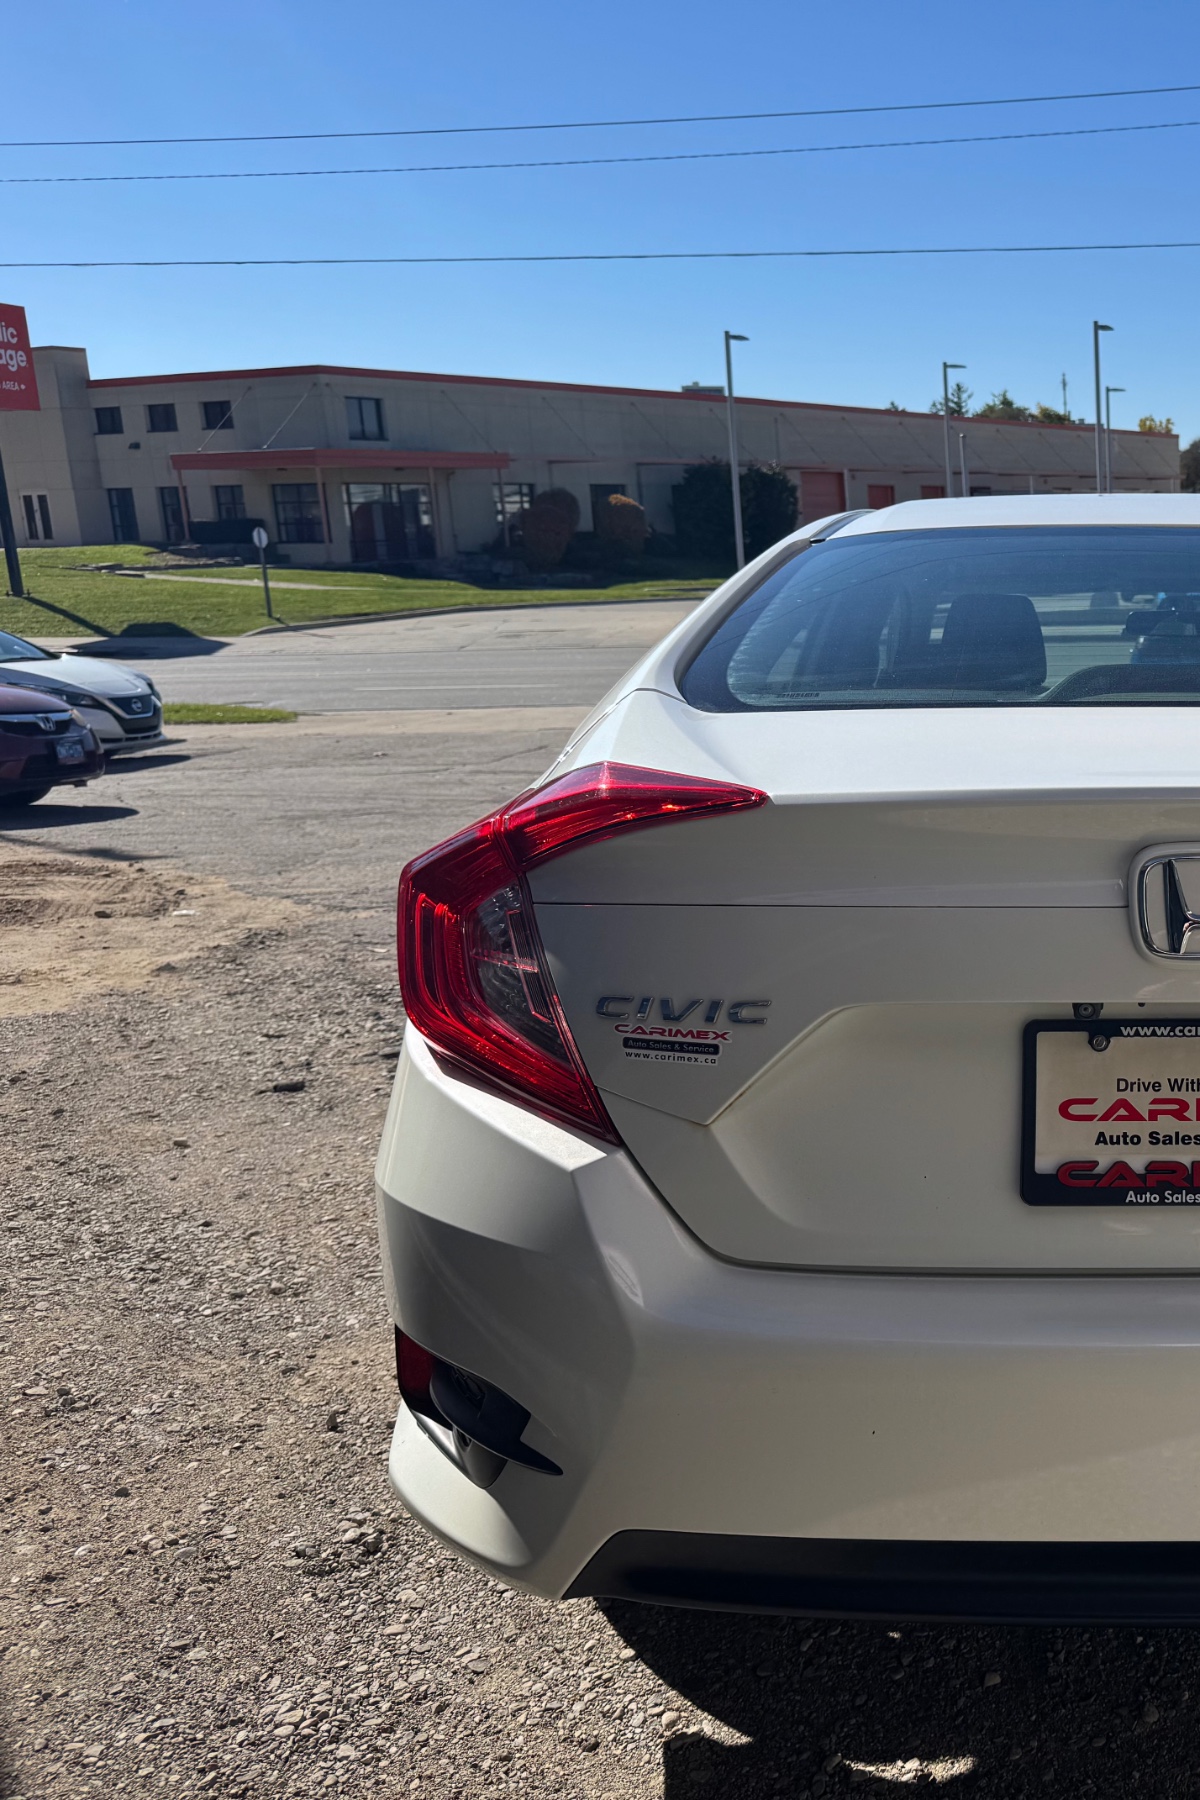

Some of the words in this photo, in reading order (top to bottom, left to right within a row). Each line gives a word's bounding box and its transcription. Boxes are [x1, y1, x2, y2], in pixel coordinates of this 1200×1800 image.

[596, 995, 772, 1025] CIVIC
[614, 1023, 732, 1042] CARIMEX
[627, 1039, 647, 1048] Auto
[649, 1041, 672, 1050] Sales
[682, 1044, 715, 1053] Service
[625, 1051, 717, 1065] www.carimex.ca
[1116, 1077, 1162, 1093] Drive
[1094, 1131, 1142, 1146] Auto
[1125, 1190, 1161, 1204] Auto
